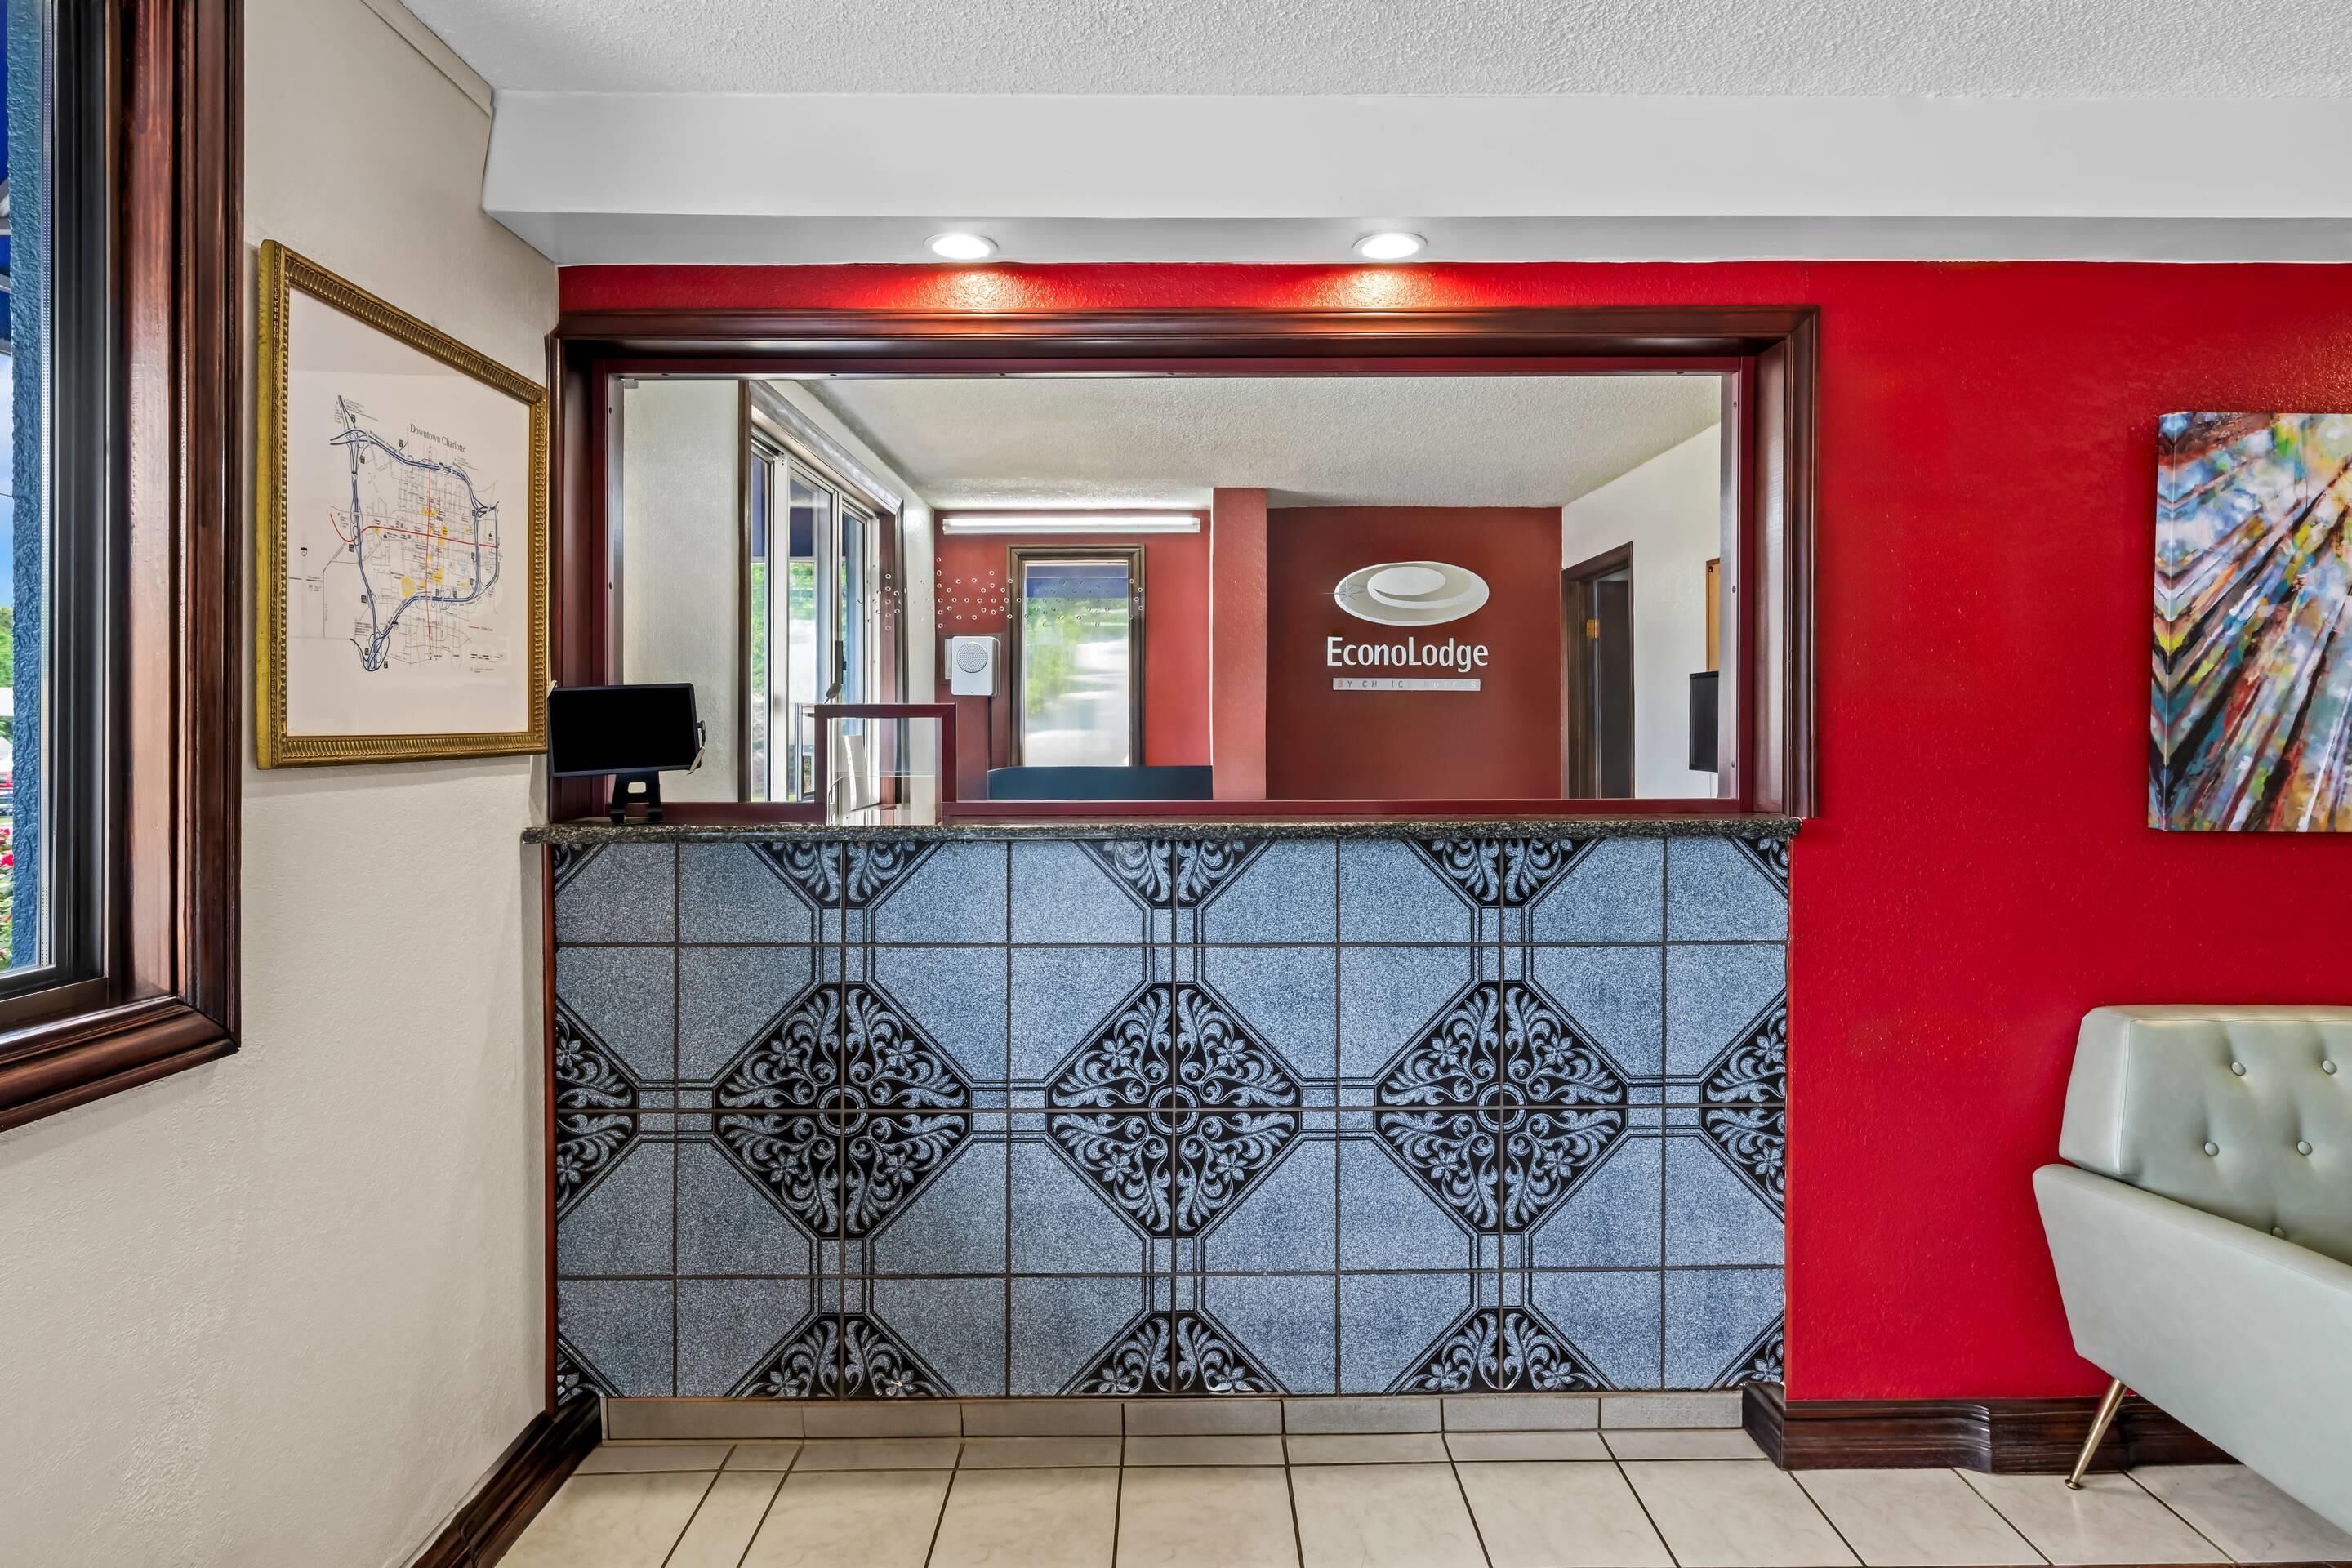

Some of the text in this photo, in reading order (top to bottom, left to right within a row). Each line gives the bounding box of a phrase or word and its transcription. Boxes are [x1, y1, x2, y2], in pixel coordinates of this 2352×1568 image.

[410, 423, 441, 443] Downtown
[441, 436, 466, 453] Charlotte
[1326, 636, 1489, 673] EconoLodge
[1338, 679, 1353, 688] BY
